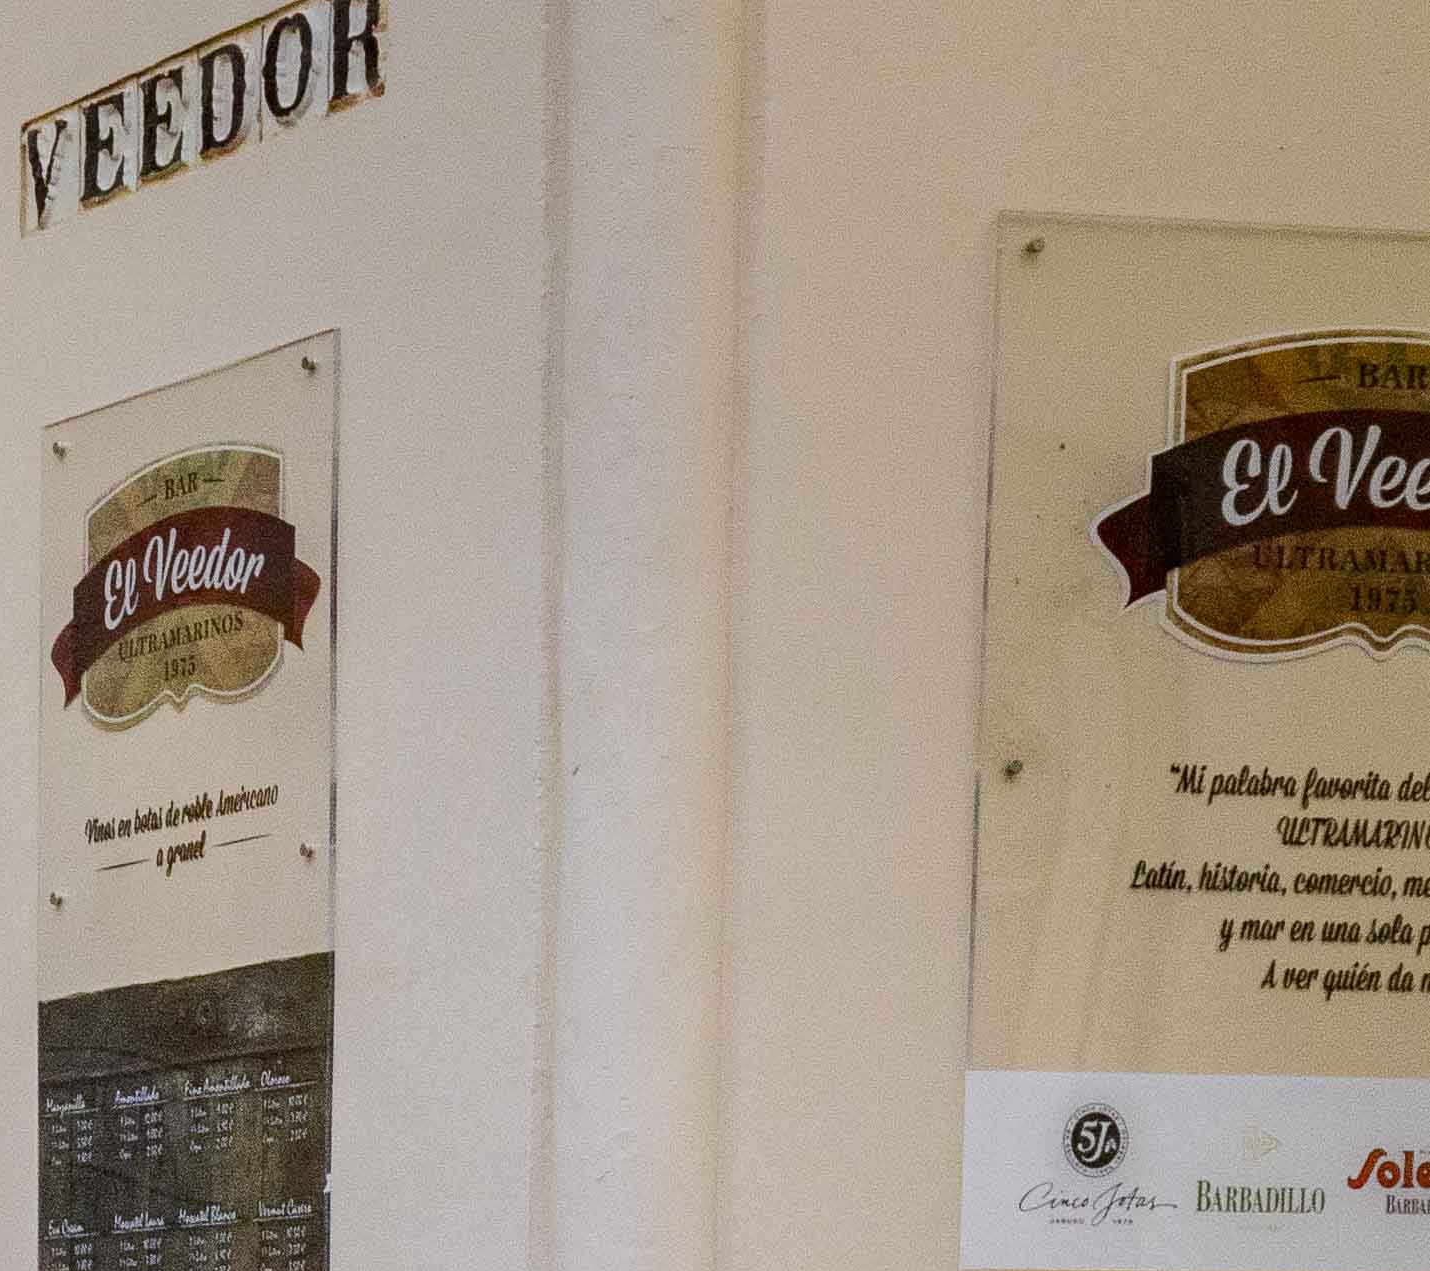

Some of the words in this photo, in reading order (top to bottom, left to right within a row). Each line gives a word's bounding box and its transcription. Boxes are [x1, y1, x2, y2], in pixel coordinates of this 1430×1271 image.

[27, 0, 385, 230] VEEDOR
[1359, 363, 1430, 389] BAR
[163, 472, 199, 501] BAR
[1220, 438, 1299, 527] El
[103, 558, 139, 631] El
[143, 527, 267, 602] Veedor
[118, 609, 245, 664] ULTRAMARINOS
[163, 655, 197, 682] 1975
[1208, 765, 1298, 806] palabra
[1302, 768, 1392, 810] favorita
[84, 816, 116, 846] Vinos
[117, 817, 132, 839] en
[134, 807, 163, 836] botas
[165, 800, 180, 829] de
[181, 791, 213, 824] roble
[216, 784, 279, 818] Americano
[166, 829, 207, 879] granel
[1199, 862, 1288, 896] historia,
[1294, 867, 1398, 902] comercio,
[1218, 917, 1234, 952] y
[1240, 918, 1286, 942] mar
[1289, 918, 1315, 943] en
[1321, 919, 1361, 943] una
[1366, 913, 1414, 946] sola
[1260, 960, 1278, 990] A
[1283, 967, 1319, 990] ver
[1323, 961, 1382, 1001] quién
[1389, 962, 1415, 993] da
[1386, 1194, 1430, 1215] BARBA
